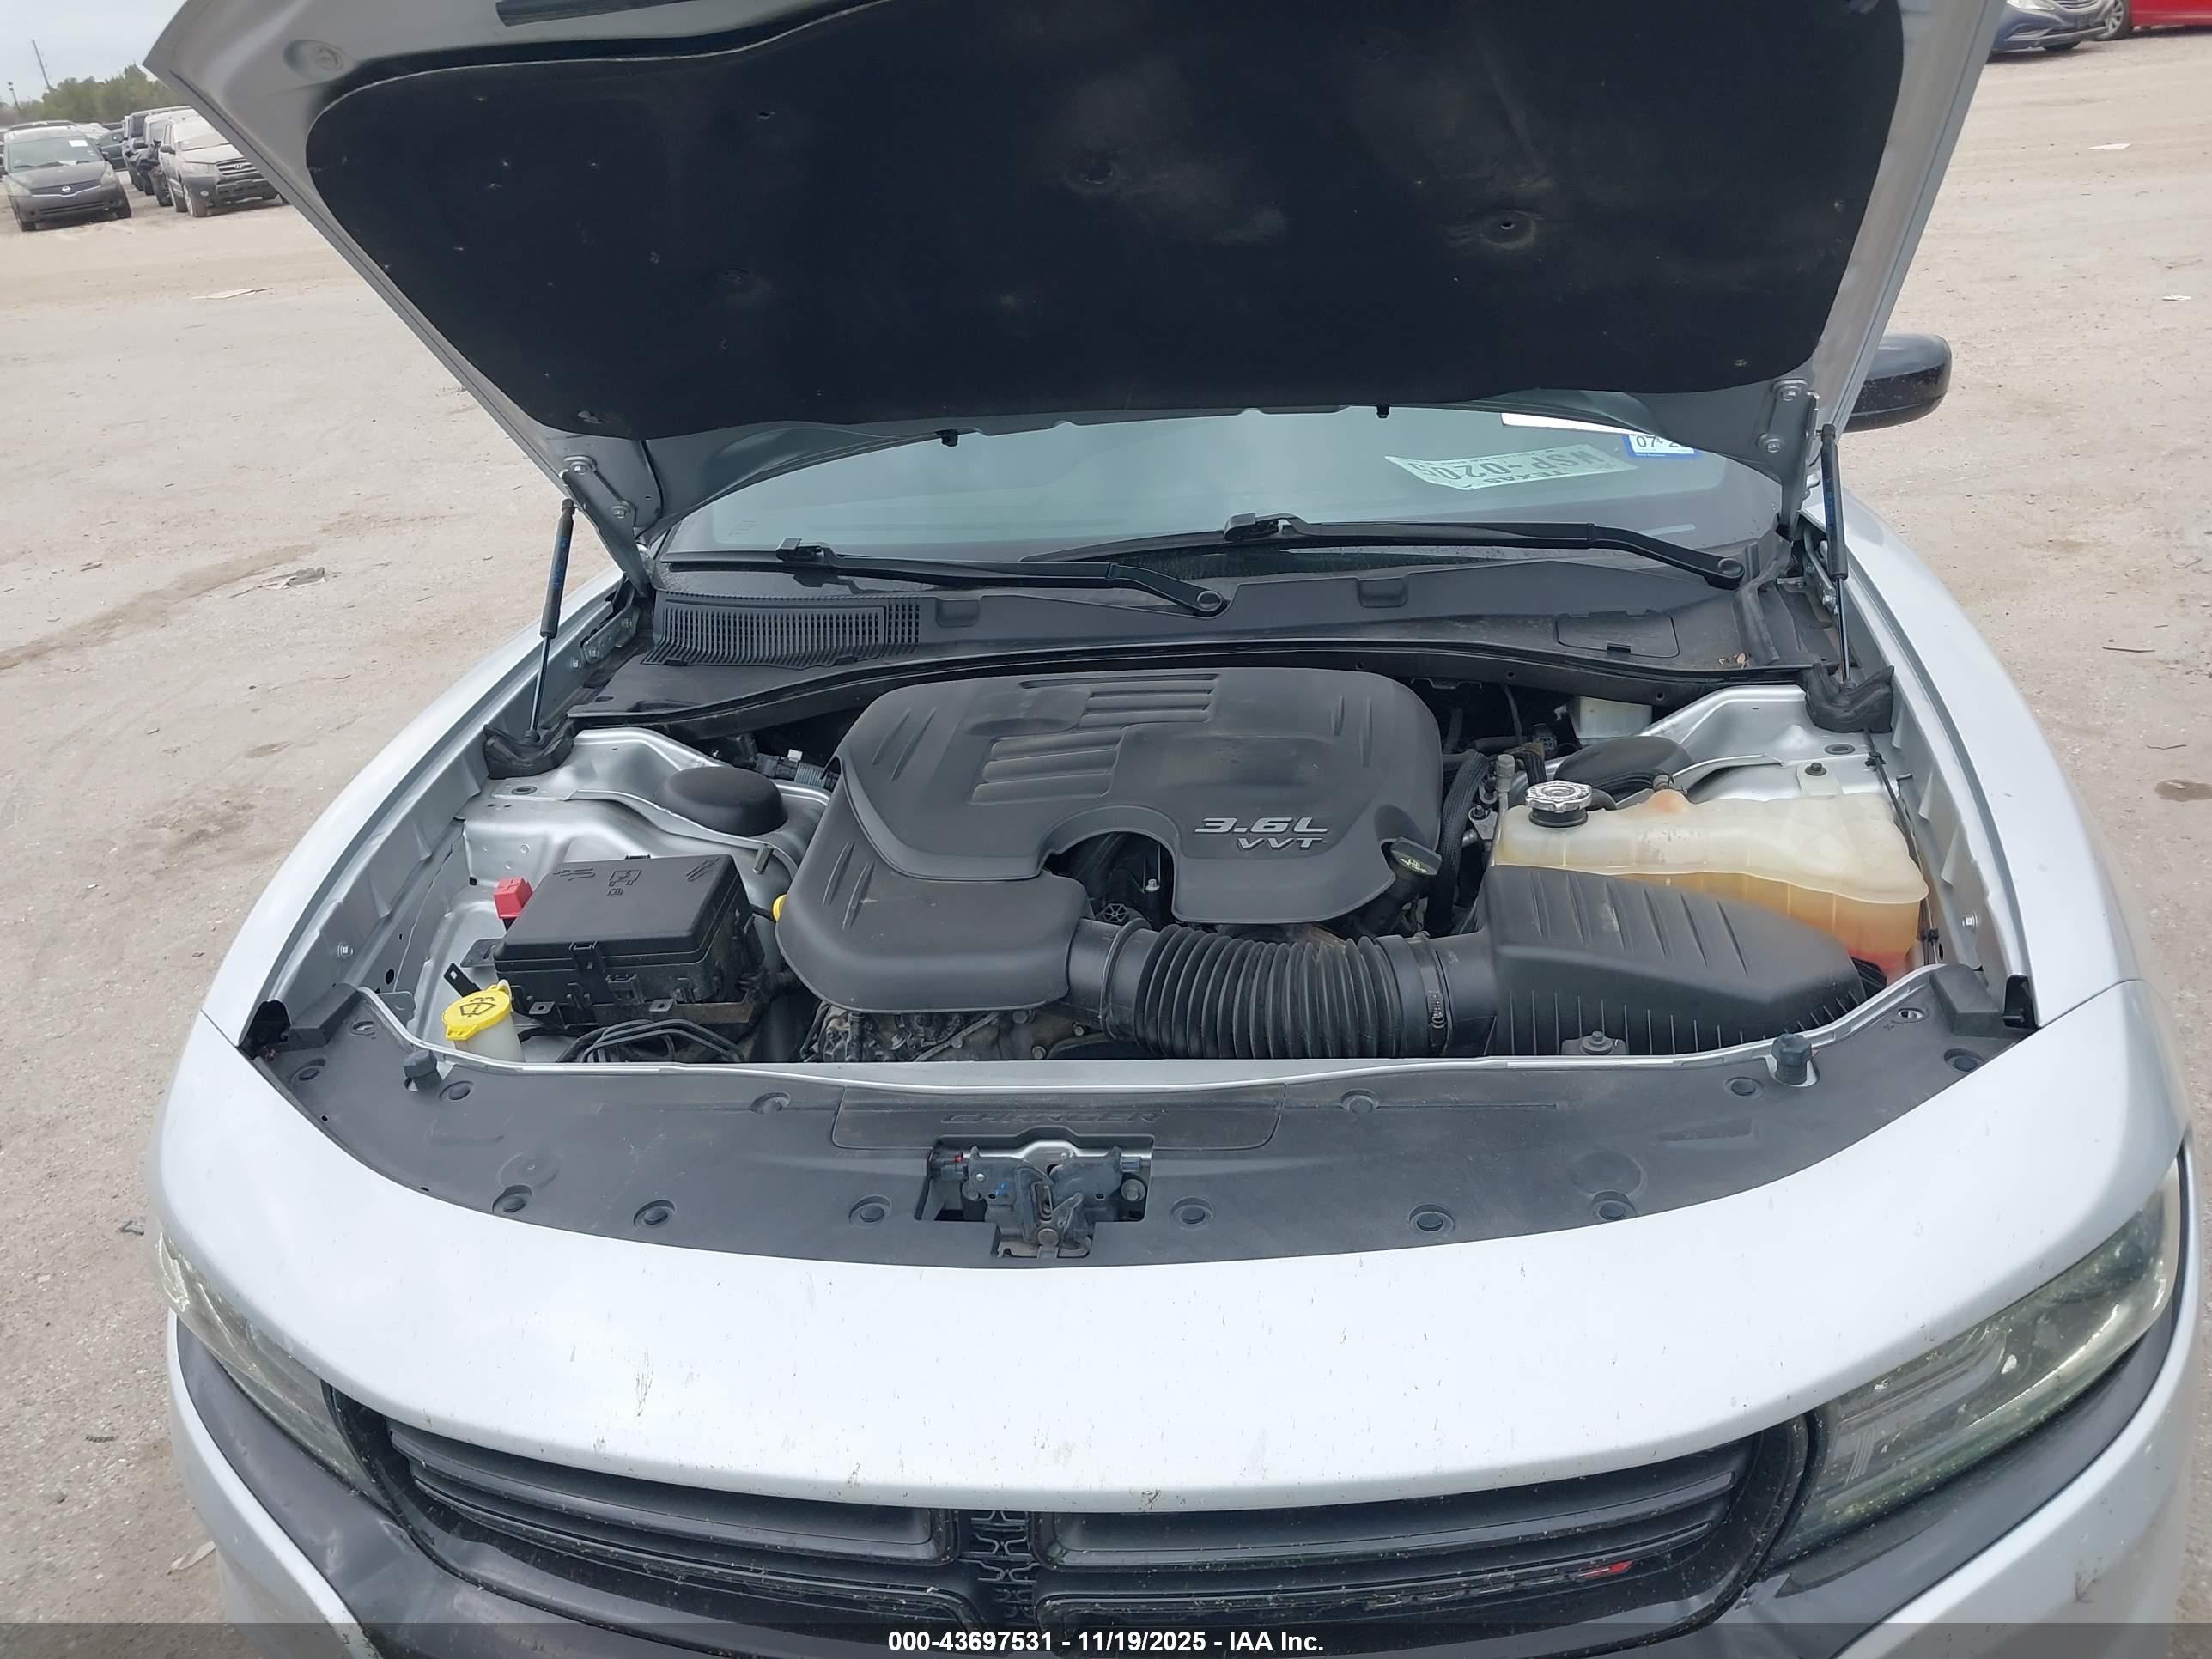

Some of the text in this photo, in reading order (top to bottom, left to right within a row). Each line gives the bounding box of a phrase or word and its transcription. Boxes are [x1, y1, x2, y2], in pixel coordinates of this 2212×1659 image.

[1636, 434, 1656, 447] 07
[1483, 470, 1571, 483] TEXAS
[1194, 817, 1328, 835] 3.6L
[1237, 836, 1324, 851] VVT
